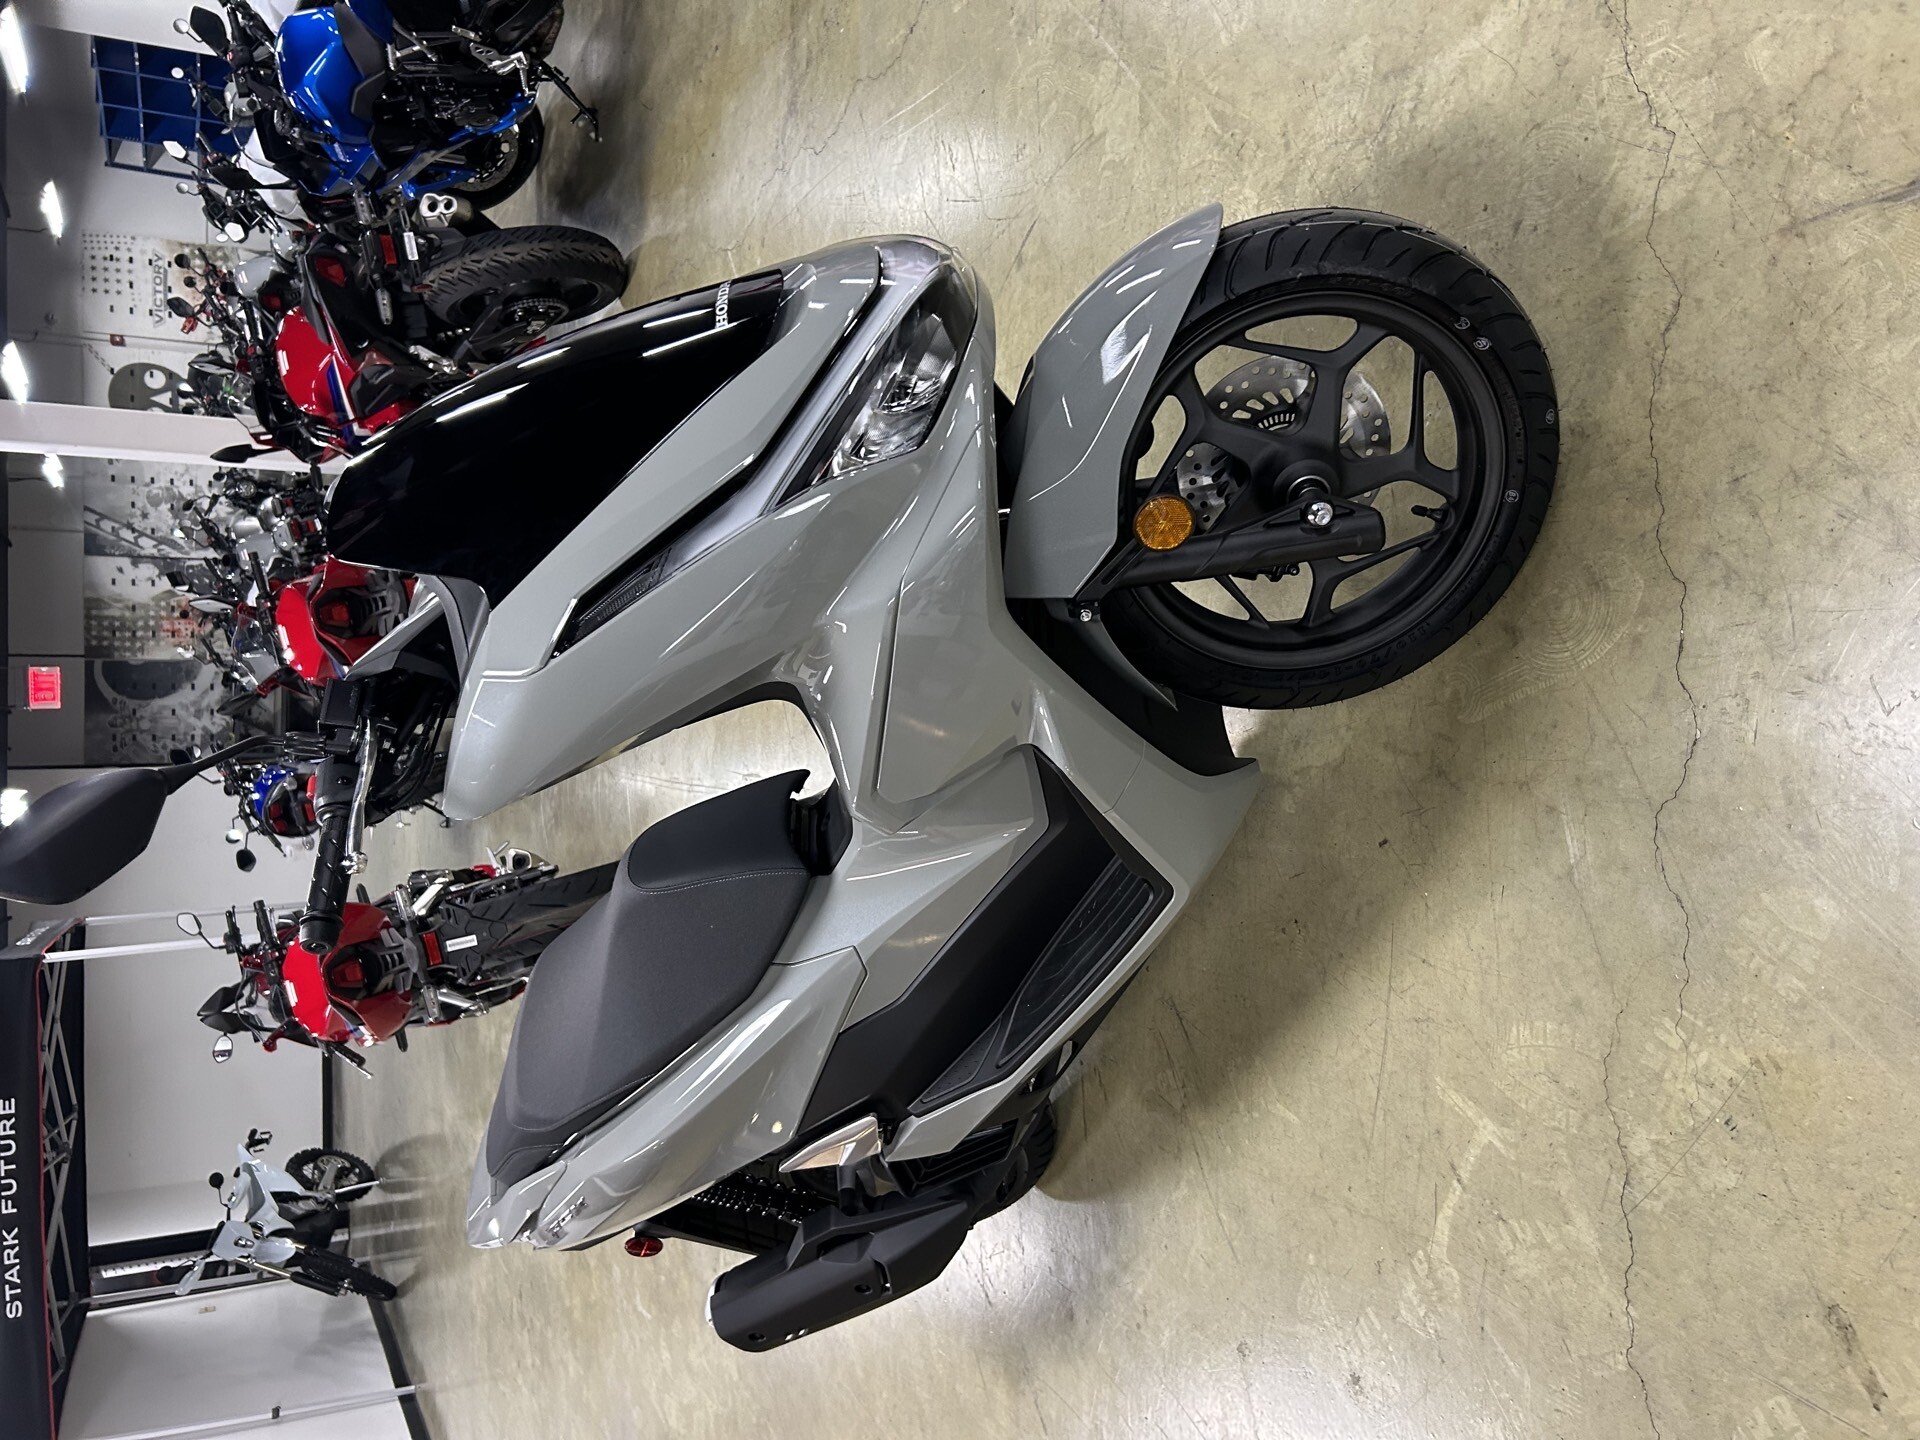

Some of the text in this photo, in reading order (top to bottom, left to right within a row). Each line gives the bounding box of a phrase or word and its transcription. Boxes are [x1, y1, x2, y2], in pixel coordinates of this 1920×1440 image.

[152, 252, 164, 325] VICTORY
[715, 280, 731, 328] HONDA
[0, 1098, 22, 1318] STARK FUTURE
